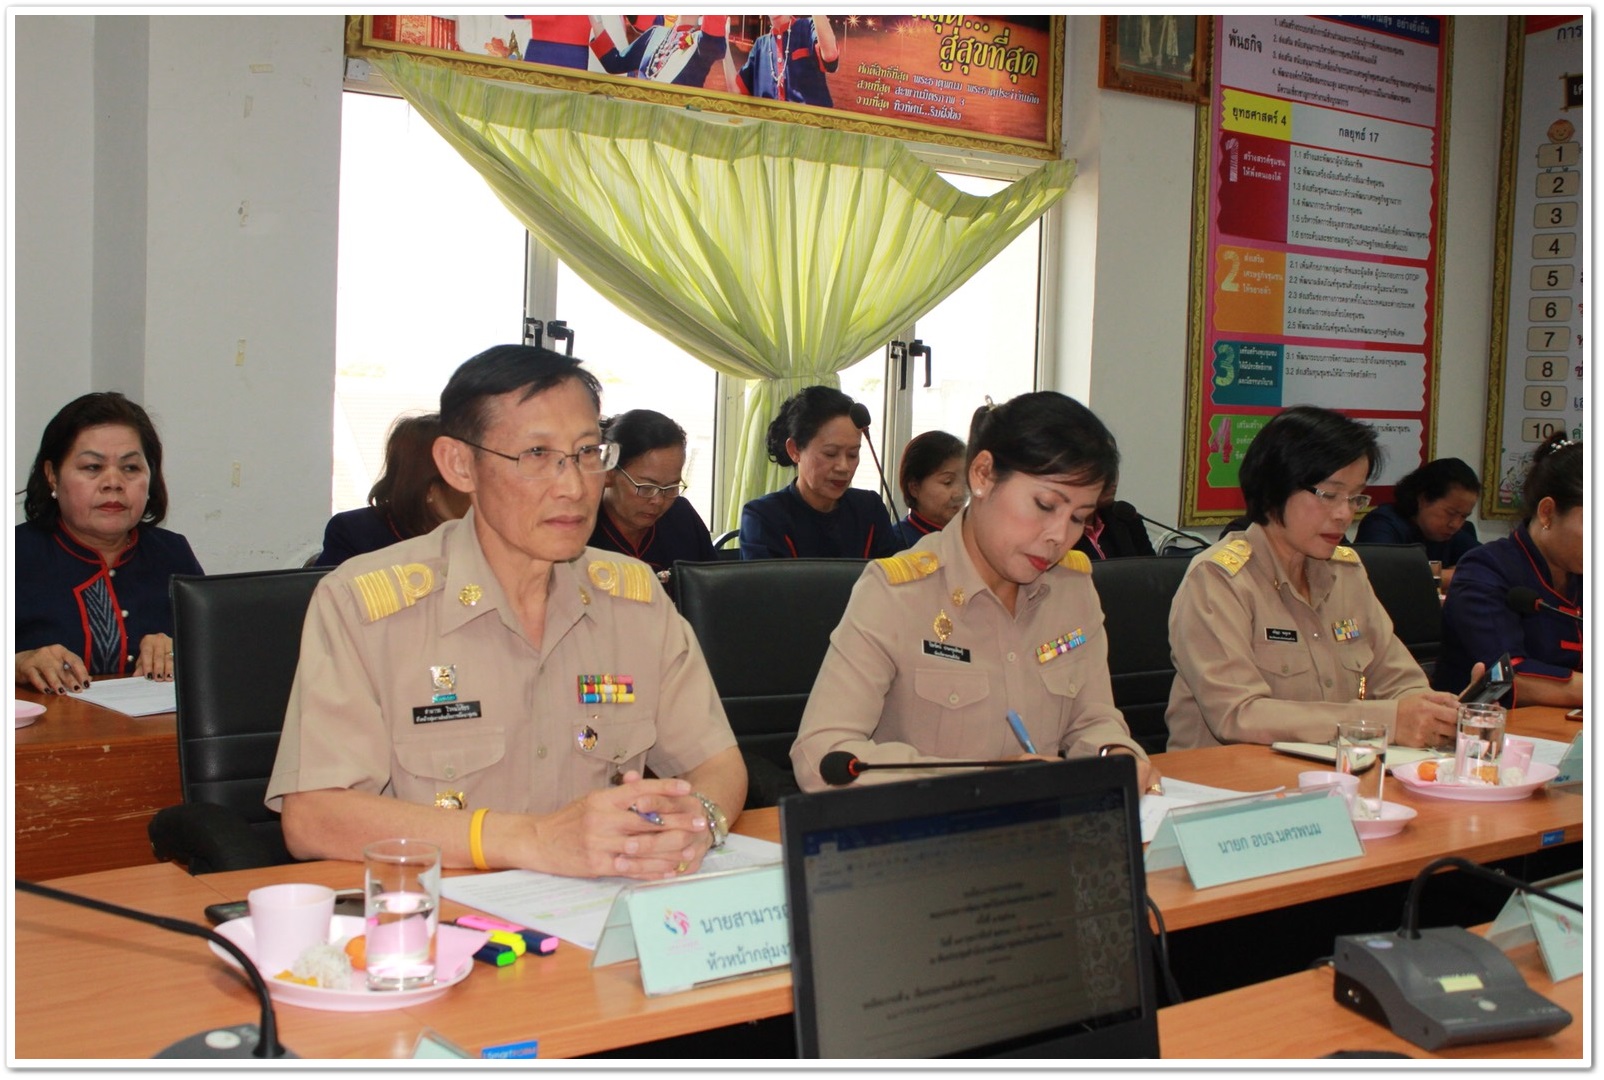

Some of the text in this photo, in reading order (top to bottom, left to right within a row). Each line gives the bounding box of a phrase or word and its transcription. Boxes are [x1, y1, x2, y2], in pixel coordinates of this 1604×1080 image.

[1229, 29, 1262, 54] พันธกิจ
[939, 25, 1039, 84] สู่สุขที่สุด
[912, 74, 963, 92] พระธาตุพนม
[856, 78, 891, 96] สวยที่สุด
[894, 85, 956, 105] สะพานมิตรภาพ
[855, 93, 890, 111] งามที่สุด
[1232, 106, 1287, 126] ยุทธศาสตร์ 4
[1338, 127, 1379, 143] กลยุทธ์ 17
[1556, 147, 1563, 161] 1
[1553, 177, 1564, 193] 2
[1551, 208, 1562, 224] 3
[1549, 238, 1560, 254] 4
[1405, 273, 1420, 282] OTOP
[1547, 271, 1558, 286] 5
[1545, 302, 1557, 318] 6
[1544, 332, 1555, 347] 7
[1542, 362, 1553, 377] 8
[1540, 391, 1551, 407] 9
[1533, 424, 1554, 439] 10
[1218, 822, 1322, 854] นายก อบจ.นครพนม
